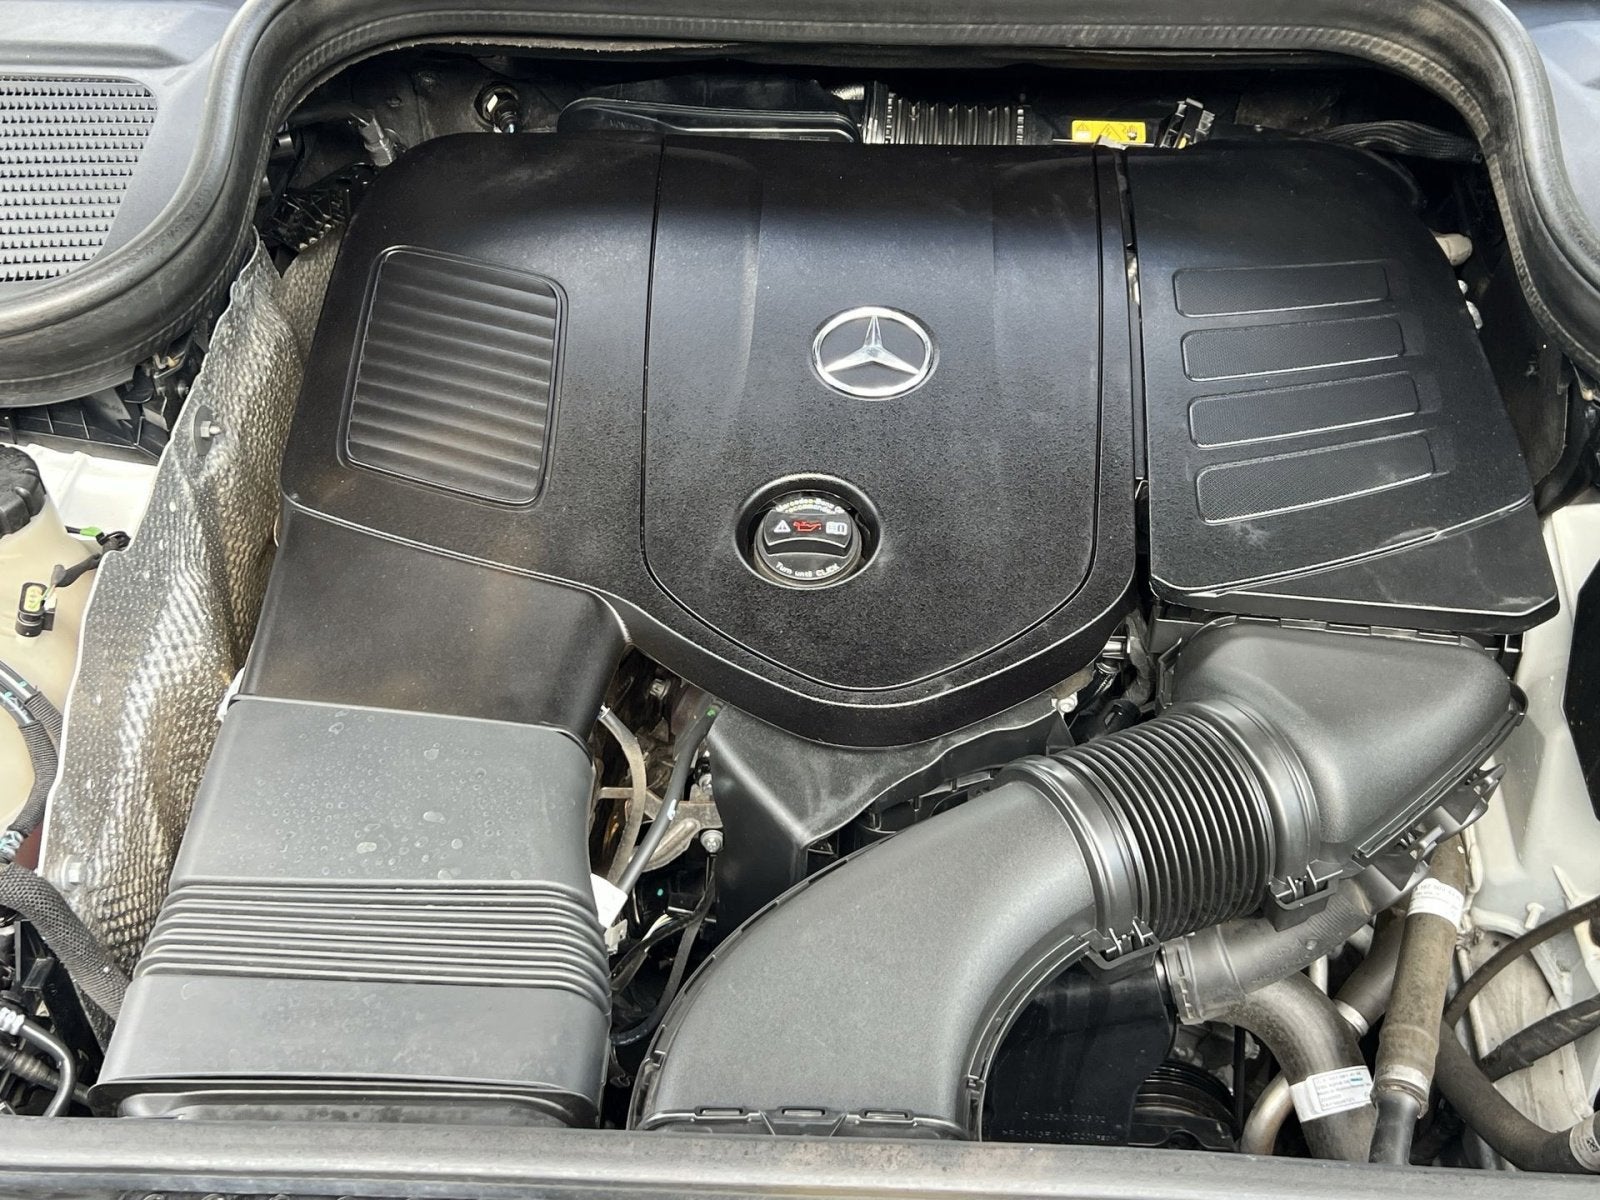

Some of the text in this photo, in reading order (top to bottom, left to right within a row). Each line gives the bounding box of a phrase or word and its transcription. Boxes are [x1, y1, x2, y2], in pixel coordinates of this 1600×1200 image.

[775, 561, 841, 578] Turn until CLICK
